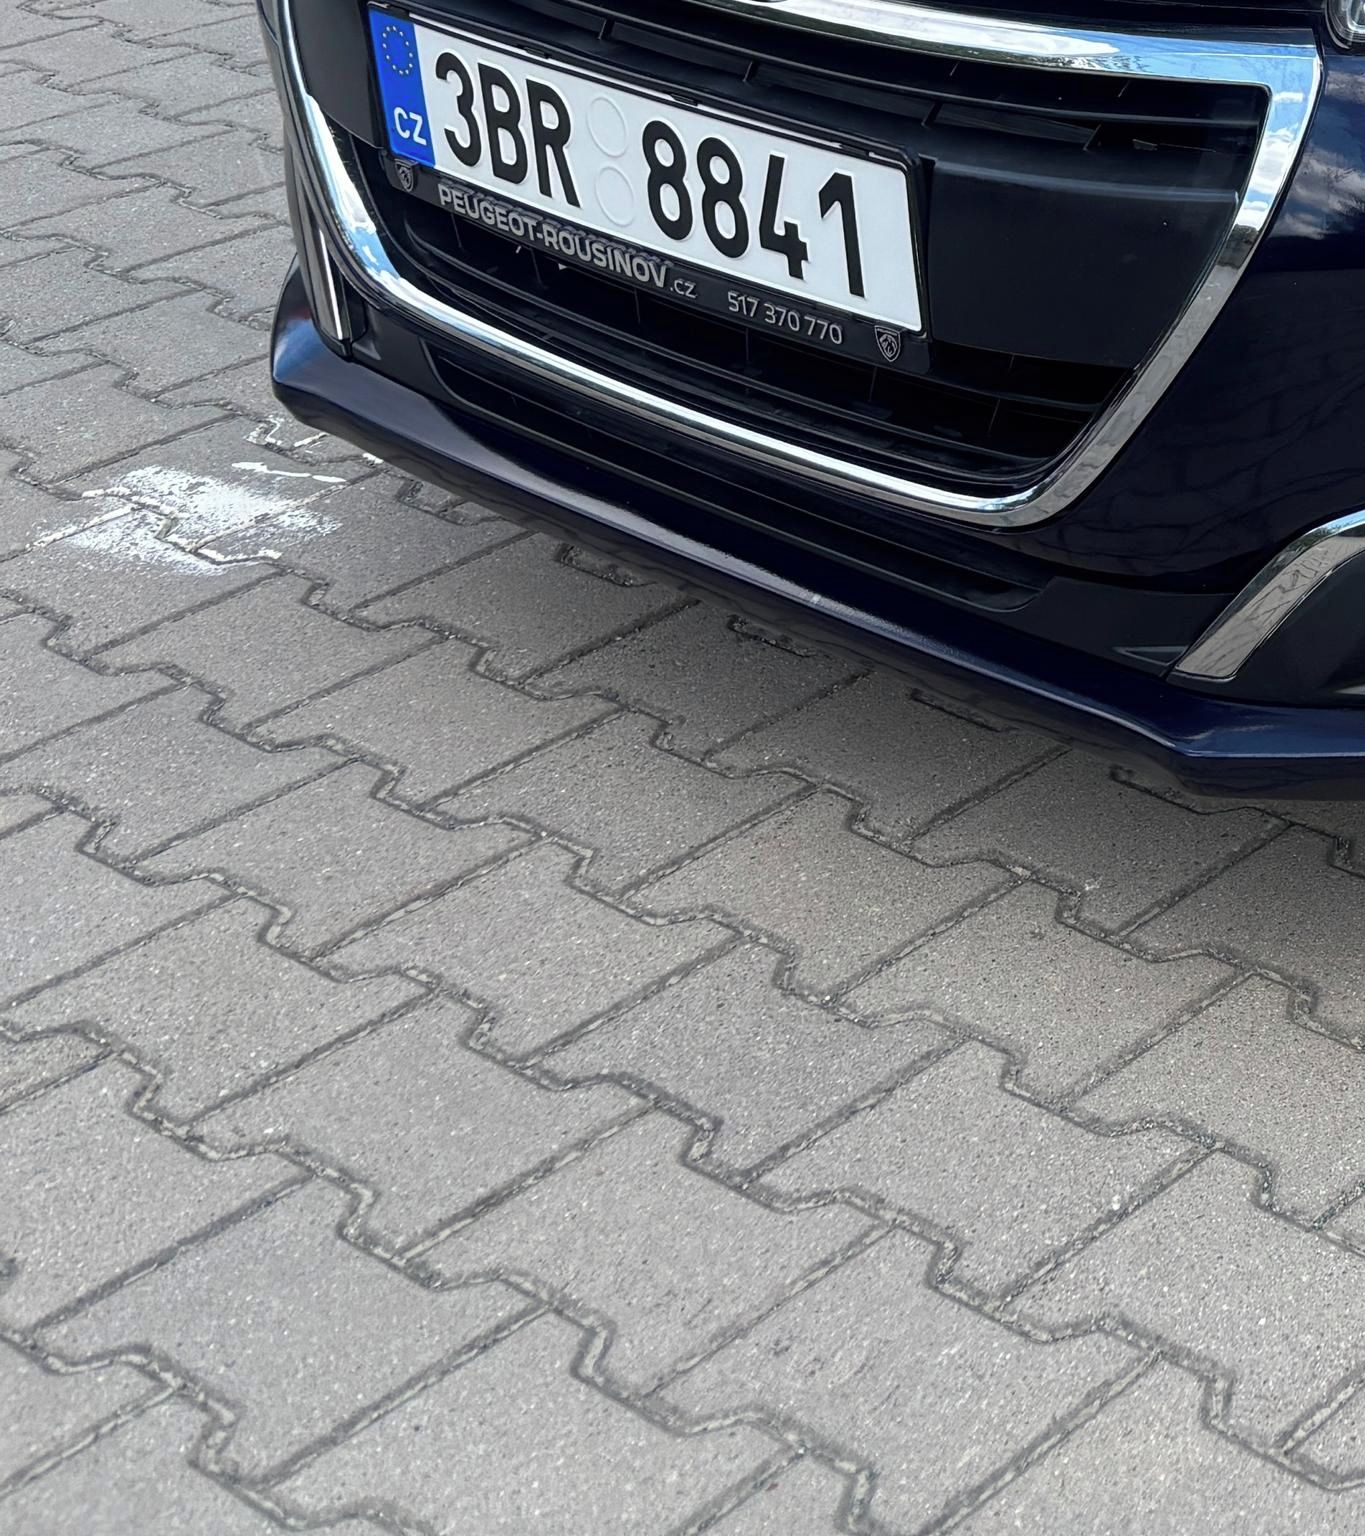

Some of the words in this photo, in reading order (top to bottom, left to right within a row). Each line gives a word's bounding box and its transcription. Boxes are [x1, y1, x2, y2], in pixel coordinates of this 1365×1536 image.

[392, 106, 427, 146] CZ
[435, 50, 583, 210] 3BR
[641, 119, 867, 300] 8841
[727, 290, 760, 320] 517
[765, 301, 800, 333] 370
[804, 312, 844, 346] 770
